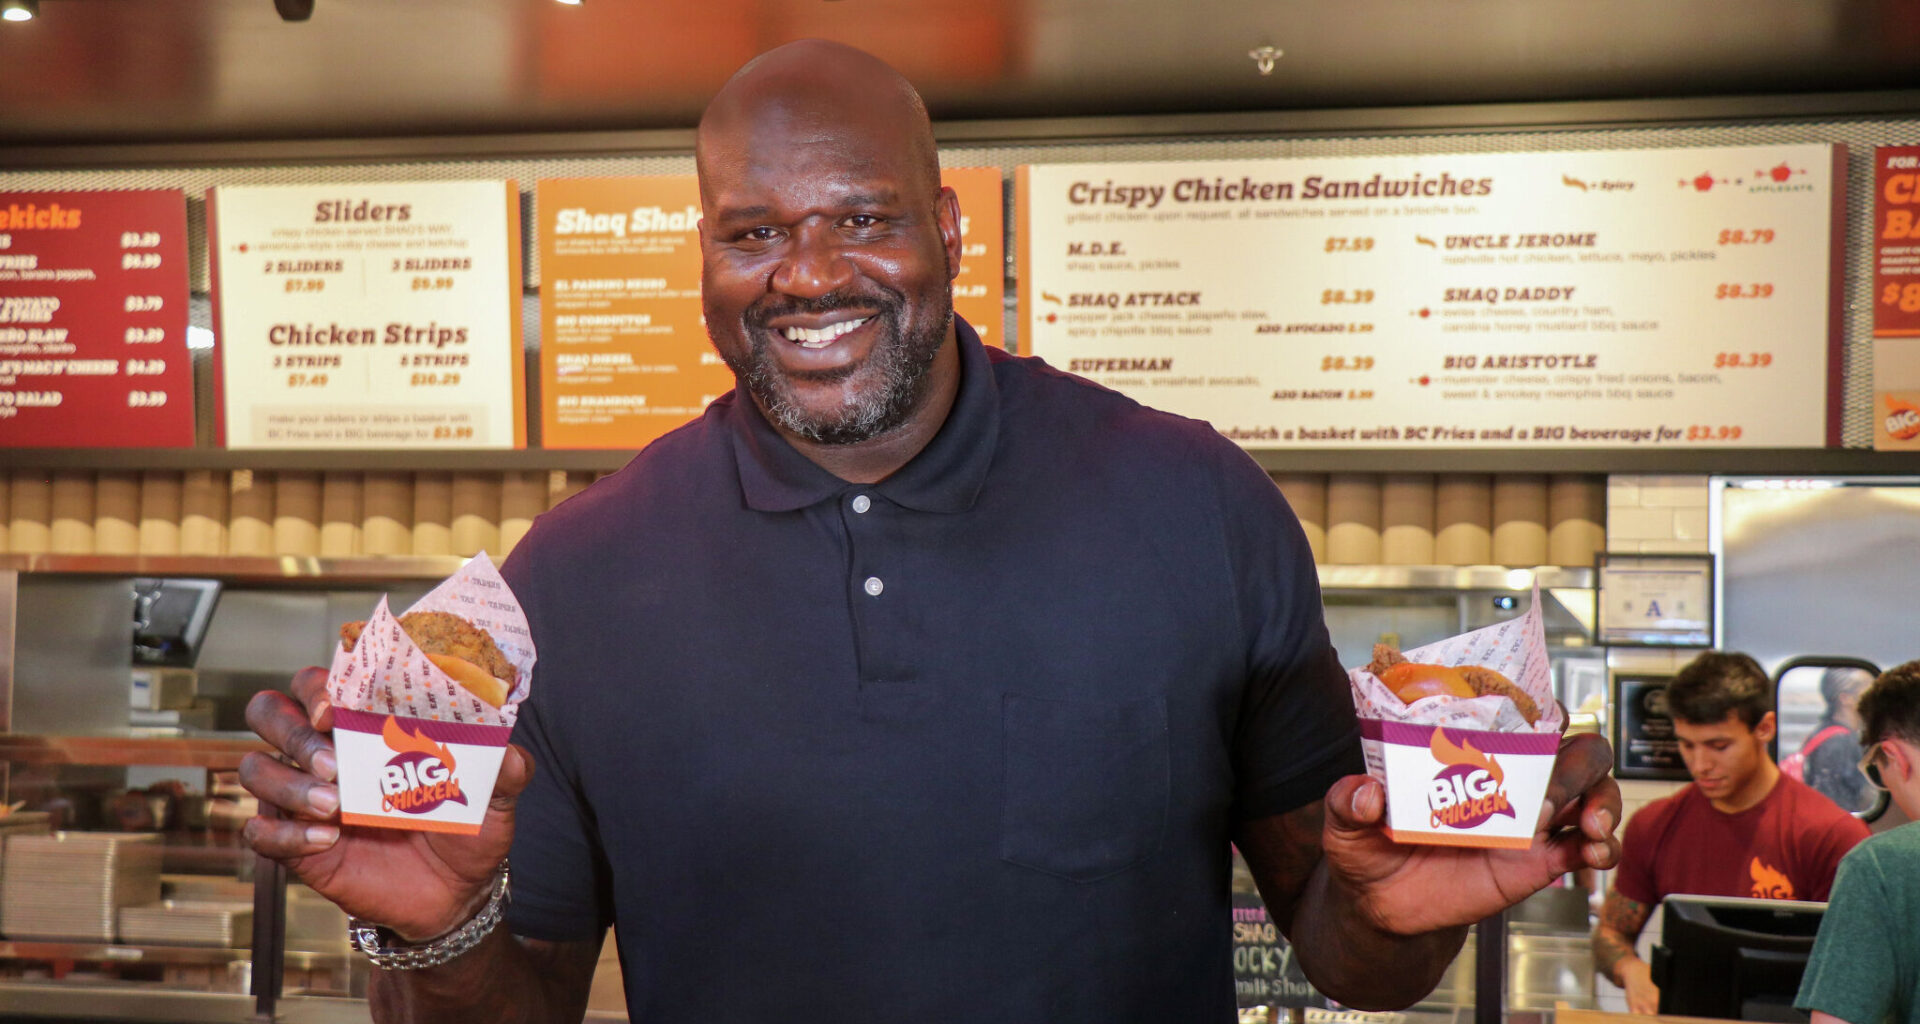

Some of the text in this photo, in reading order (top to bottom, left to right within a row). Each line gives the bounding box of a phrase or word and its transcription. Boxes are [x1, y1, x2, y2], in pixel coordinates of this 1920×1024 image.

[1068, 173, 1493, 209] Crispy Chicken Sandwiches
[1600, 180, 1635, 191] Spicy
[1749, 183, 1814, 194] APPLEGATE
[315, 200, 412, 223] Sliders
[555, 207, 627, 237] Shaq
[1067, 242, 1125, 256] M.D.E.
[1444, 229, 1775, 249] UNCLE JEROME $8.79
[405, 258, 472, 271] SLIDERS
[1670, 249, 1717, 263] pickles
[277, 260, 344, 273] SLIDERS
[1068, 289, 1375, 309] SHAQ ATTACK $8.39
[1444, 283, 1774, 303] SHAQ DADDY $8.39
[268, 322, 468, 350] Chicken Strips
[285, 355, 342, 368] STRIPS
[413, 354, 469, 367] STRIPS
[1069, 355, 1375, 372] SUPERMAN $8.39
[1444, 352, 1773, 370] BIG ARISTOTLE $8.39
[1885, 409, 1919, 433] BIG
[1283, 429, 1294, 440] a
[1298, 426, 1357, 440] basket
[1360, 426, 1400, 440] with
[1404, 427, 1429, 440] BC
[1432, 426, 1477, 440] Fries
[1480, 426, 1513, 440] and
[1517, 429, 1528, 440] a
[1532, 425, 1566, 440] BIG
[1569, 425, 1653, 443] beverage
[1655, 425, 1684, 443] for
[1686, 425, 1743, 441] $3.99
[1645, 599, 1661, 617] A
[381, 757, 450, 796] BIG
[382, 777, 461, 813] CHICKEN
[1430, 769, 1499, 810] BIG
[1430, 790, 1508, 829] CHICKEN
[1233, 922, 1277, 944] SHAQ
